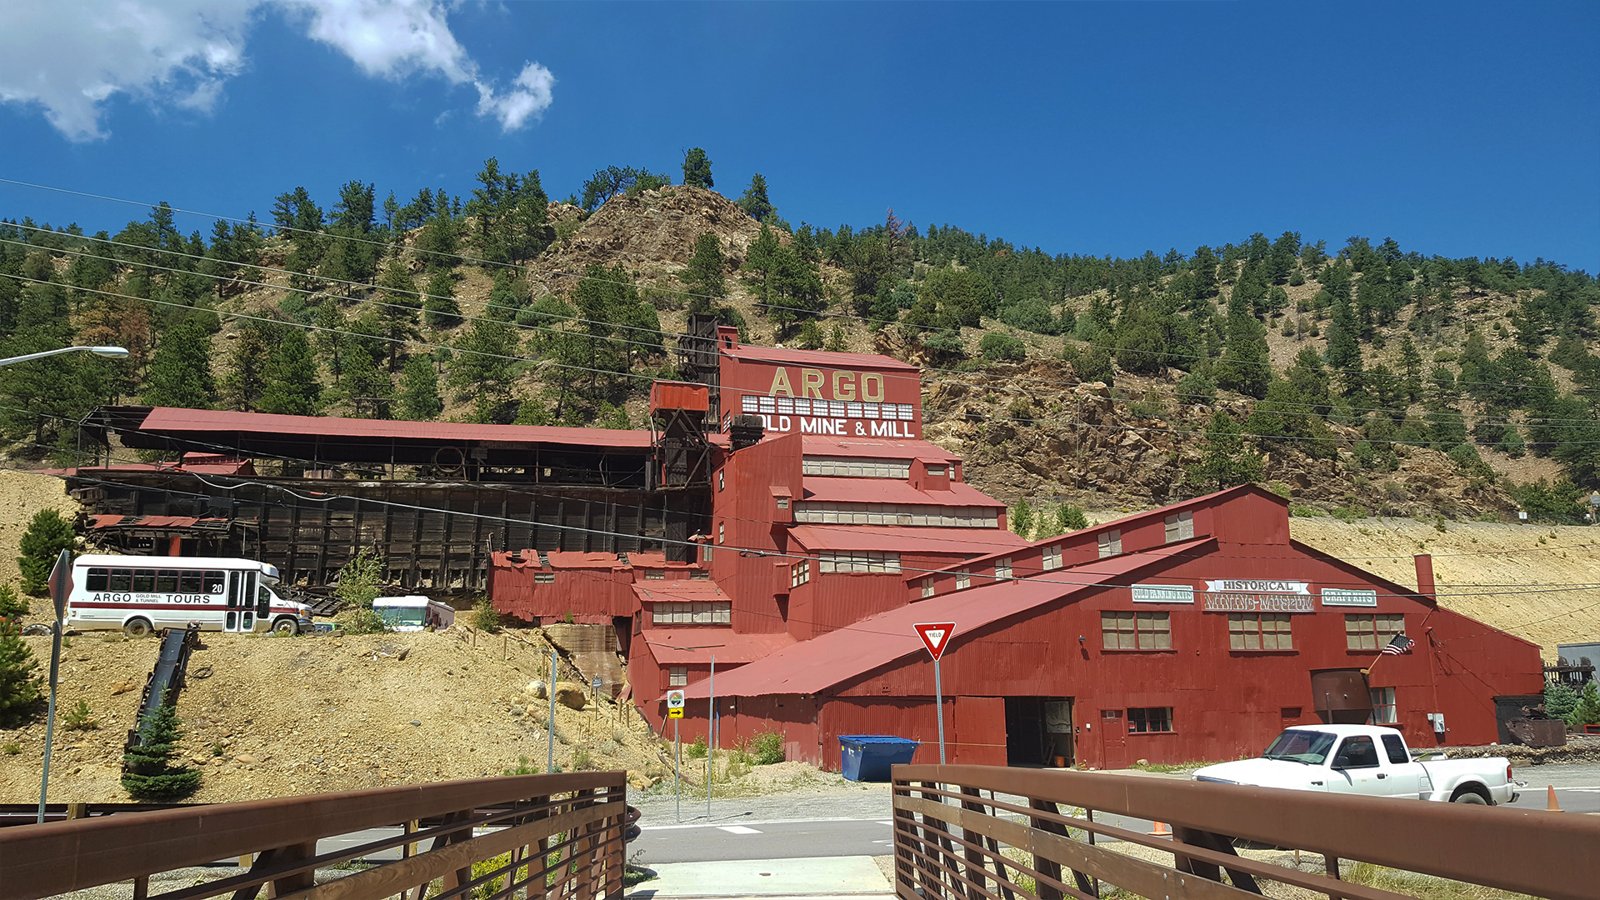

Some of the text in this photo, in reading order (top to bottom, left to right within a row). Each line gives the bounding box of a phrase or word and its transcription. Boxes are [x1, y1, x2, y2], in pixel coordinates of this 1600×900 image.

[768, 366, 885, 403] ARGO
[800, 417, 848, 435] MINE
[855, 421, 867, 436] &
[871, 420, 915, 438] MILL
[212, 583, 223, 594] 20
[1223, 580, 1294, 591] HISTORICAL
[93, 592, 132, 603] ARGO
[166, 594, 210, 604] TOURS
